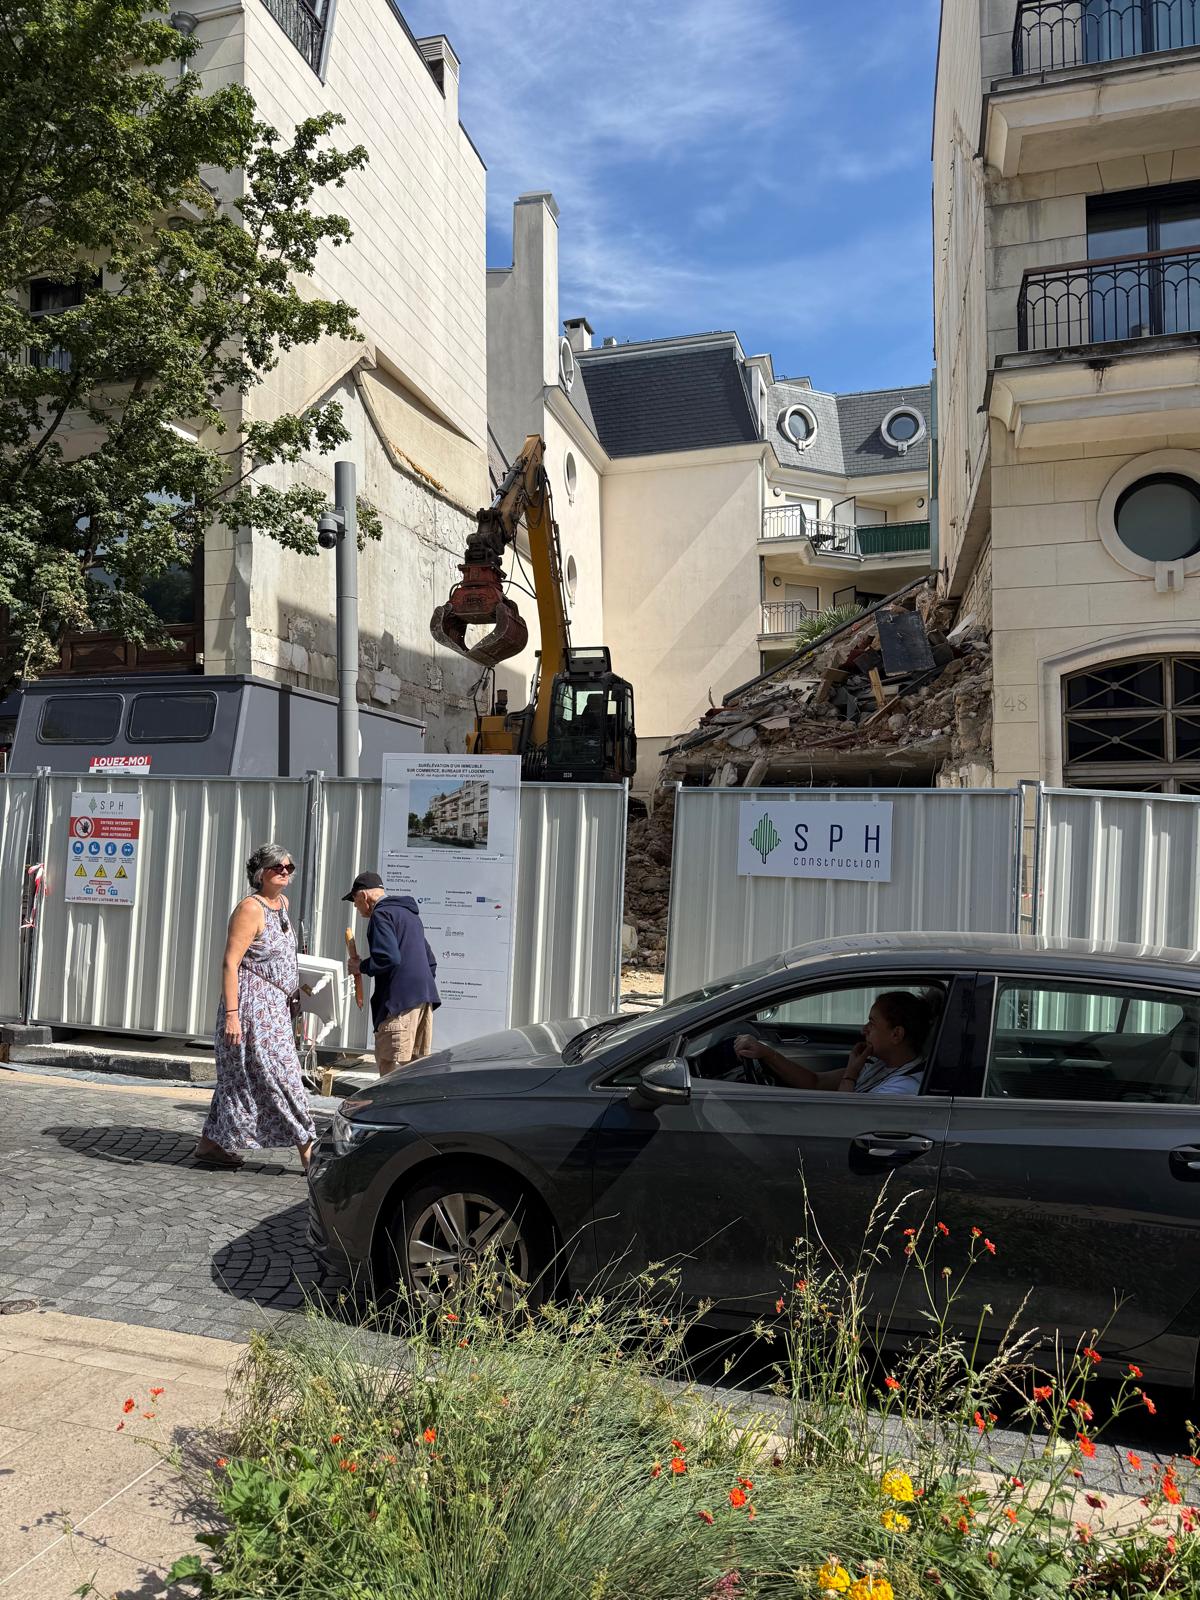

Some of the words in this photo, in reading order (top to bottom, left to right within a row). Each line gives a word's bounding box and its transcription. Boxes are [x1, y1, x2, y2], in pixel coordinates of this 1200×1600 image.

[1004, 694, 1028, 712] 48
[94, 757, 148, 766] LOUEZ-MOI
[794, 823, 880, 854] SPH
